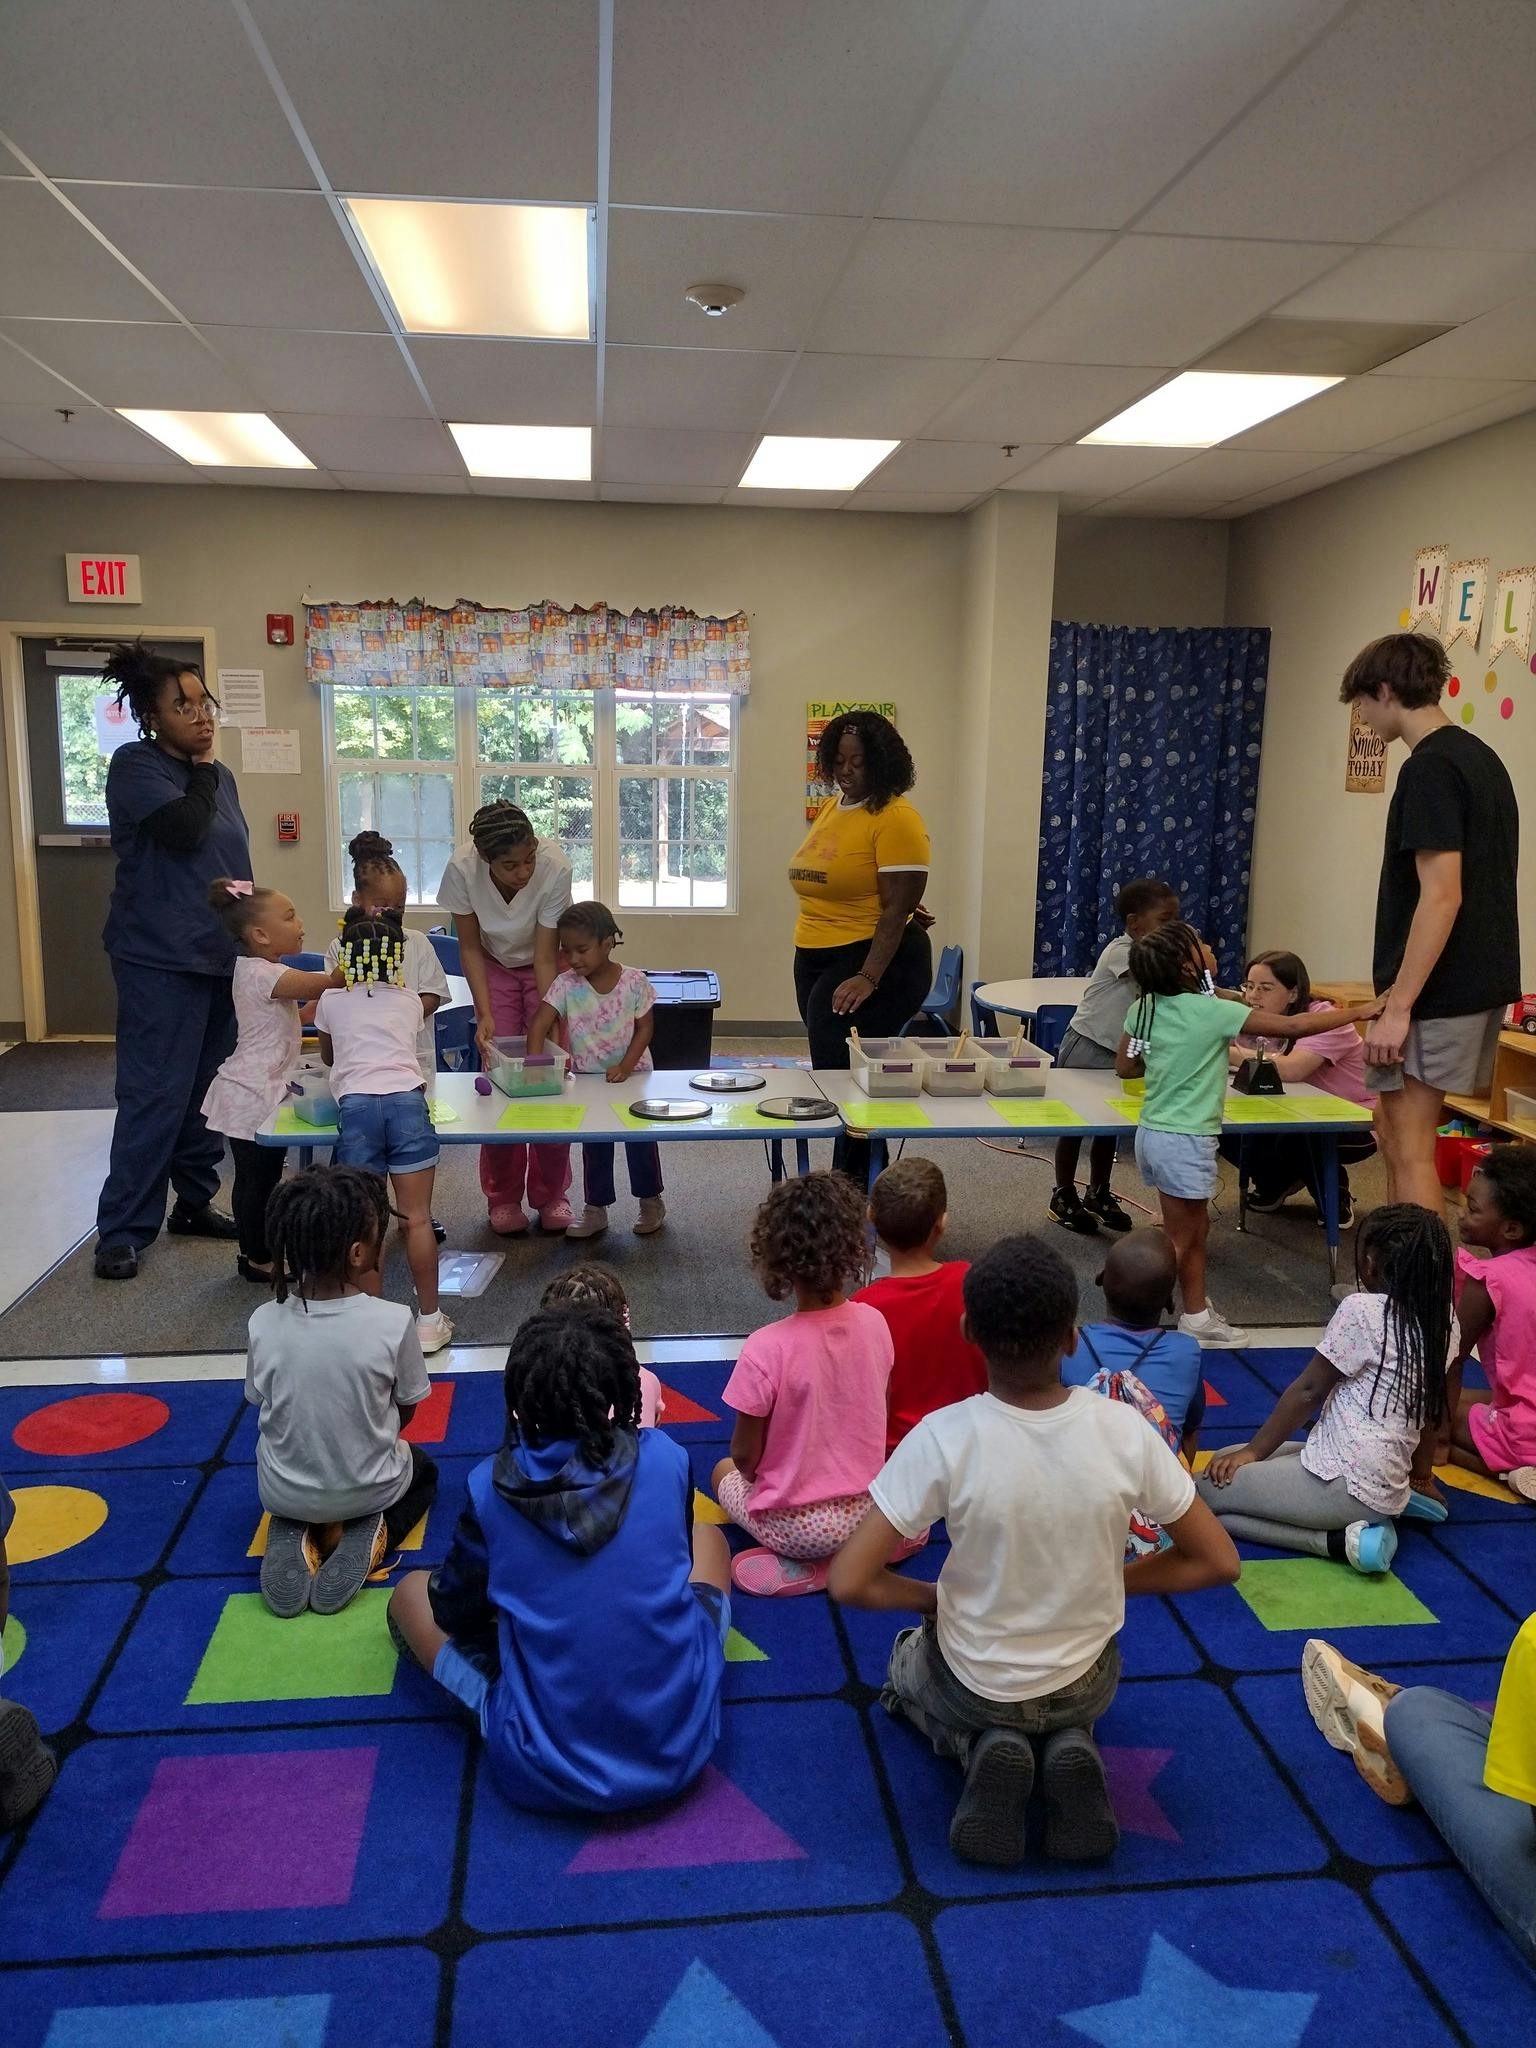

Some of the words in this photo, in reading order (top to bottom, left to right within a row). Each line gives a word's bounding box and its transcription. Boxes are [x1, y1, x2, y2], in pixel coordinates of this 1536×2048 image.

[81, 560, 126, 595] EXIT
[1350, 727, 1386, 759] Smiles
[1348, 760, 1385, 777] TODAY
[280, 814, 297, 822] FIRE
